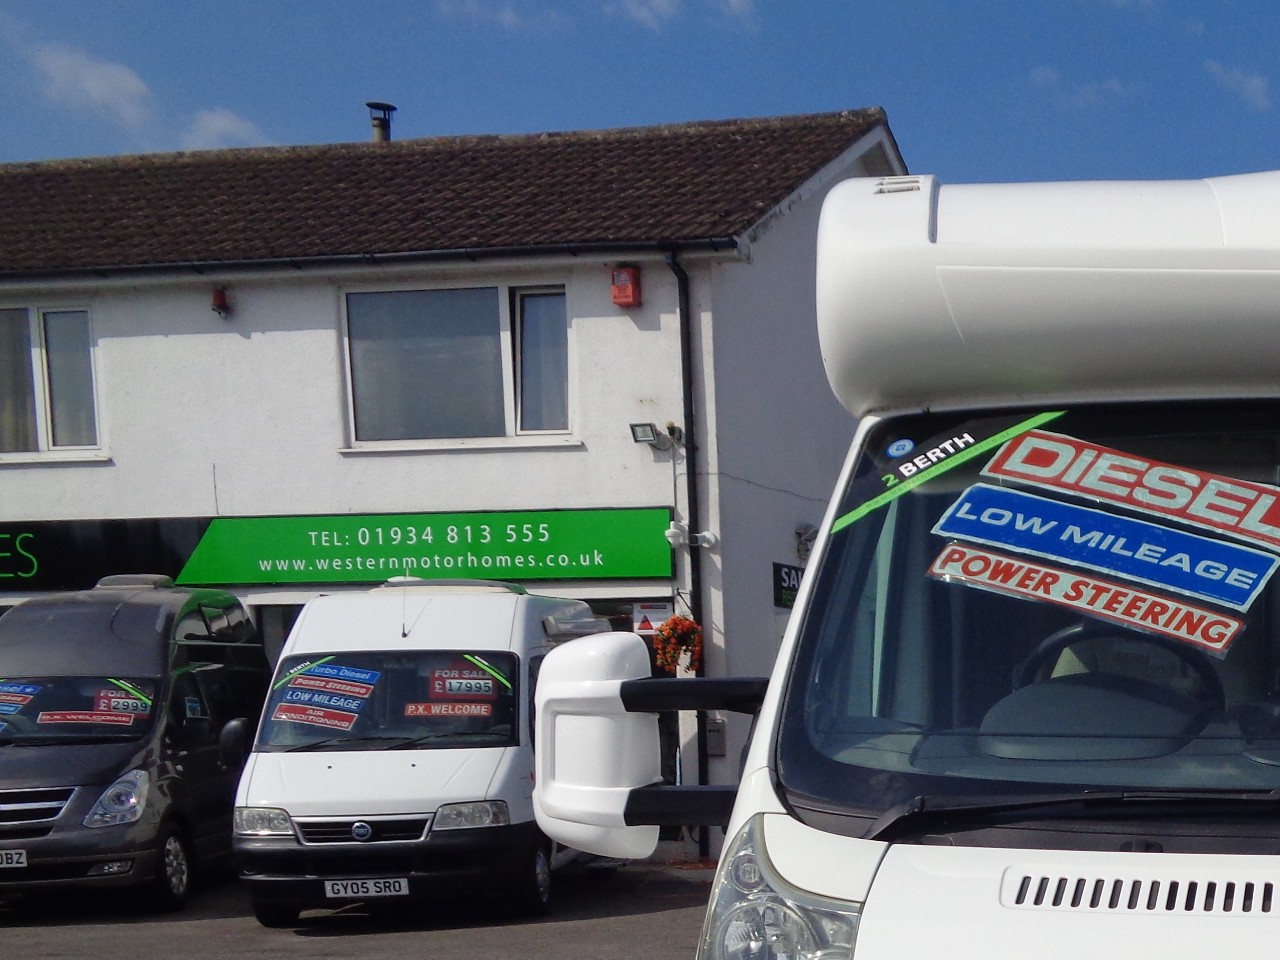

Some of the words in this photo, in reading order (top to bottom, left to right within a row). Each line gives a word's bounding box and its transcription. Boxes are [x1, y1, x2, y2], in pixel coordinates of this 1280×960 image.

[881, 473, 899, 487] 2
[898, 432, 976, 477] BERTH
[308, 531, 350, 546] TEL:
[357, 526, 434, 545] 01934
[446, 524, 491, 544] 813
[505, 523, 550, 543] 555
[955, 502, 1058, 537] LOW
[1060, 526, 1259, 589] MILEAGE
[259, 549, 604, 571] www.westernmotorhomes.co.uk
[938, 550, 1057, 596] POWER
[1062, 578, 1234, 651] STEERING
[339, 667, 371, 680] Diesel
[435, 670, 459, 678] FOR
[447, 681, 491, 693] 17995
[286, 690, 311, 701] LOW
[312, 692, 361, 710] MILEAGE
[306, 709, 324, 717] AIR
[407, 704, 428, 714] P.X.
[431, 704, 489, 715] WELCOME
[66, 714, 130, 722] WELCOME
[275, 712, 350, 728] CONDITIONING
[331, 881, 369, 895] GY05
[373, 880, 402, 894] SRO
